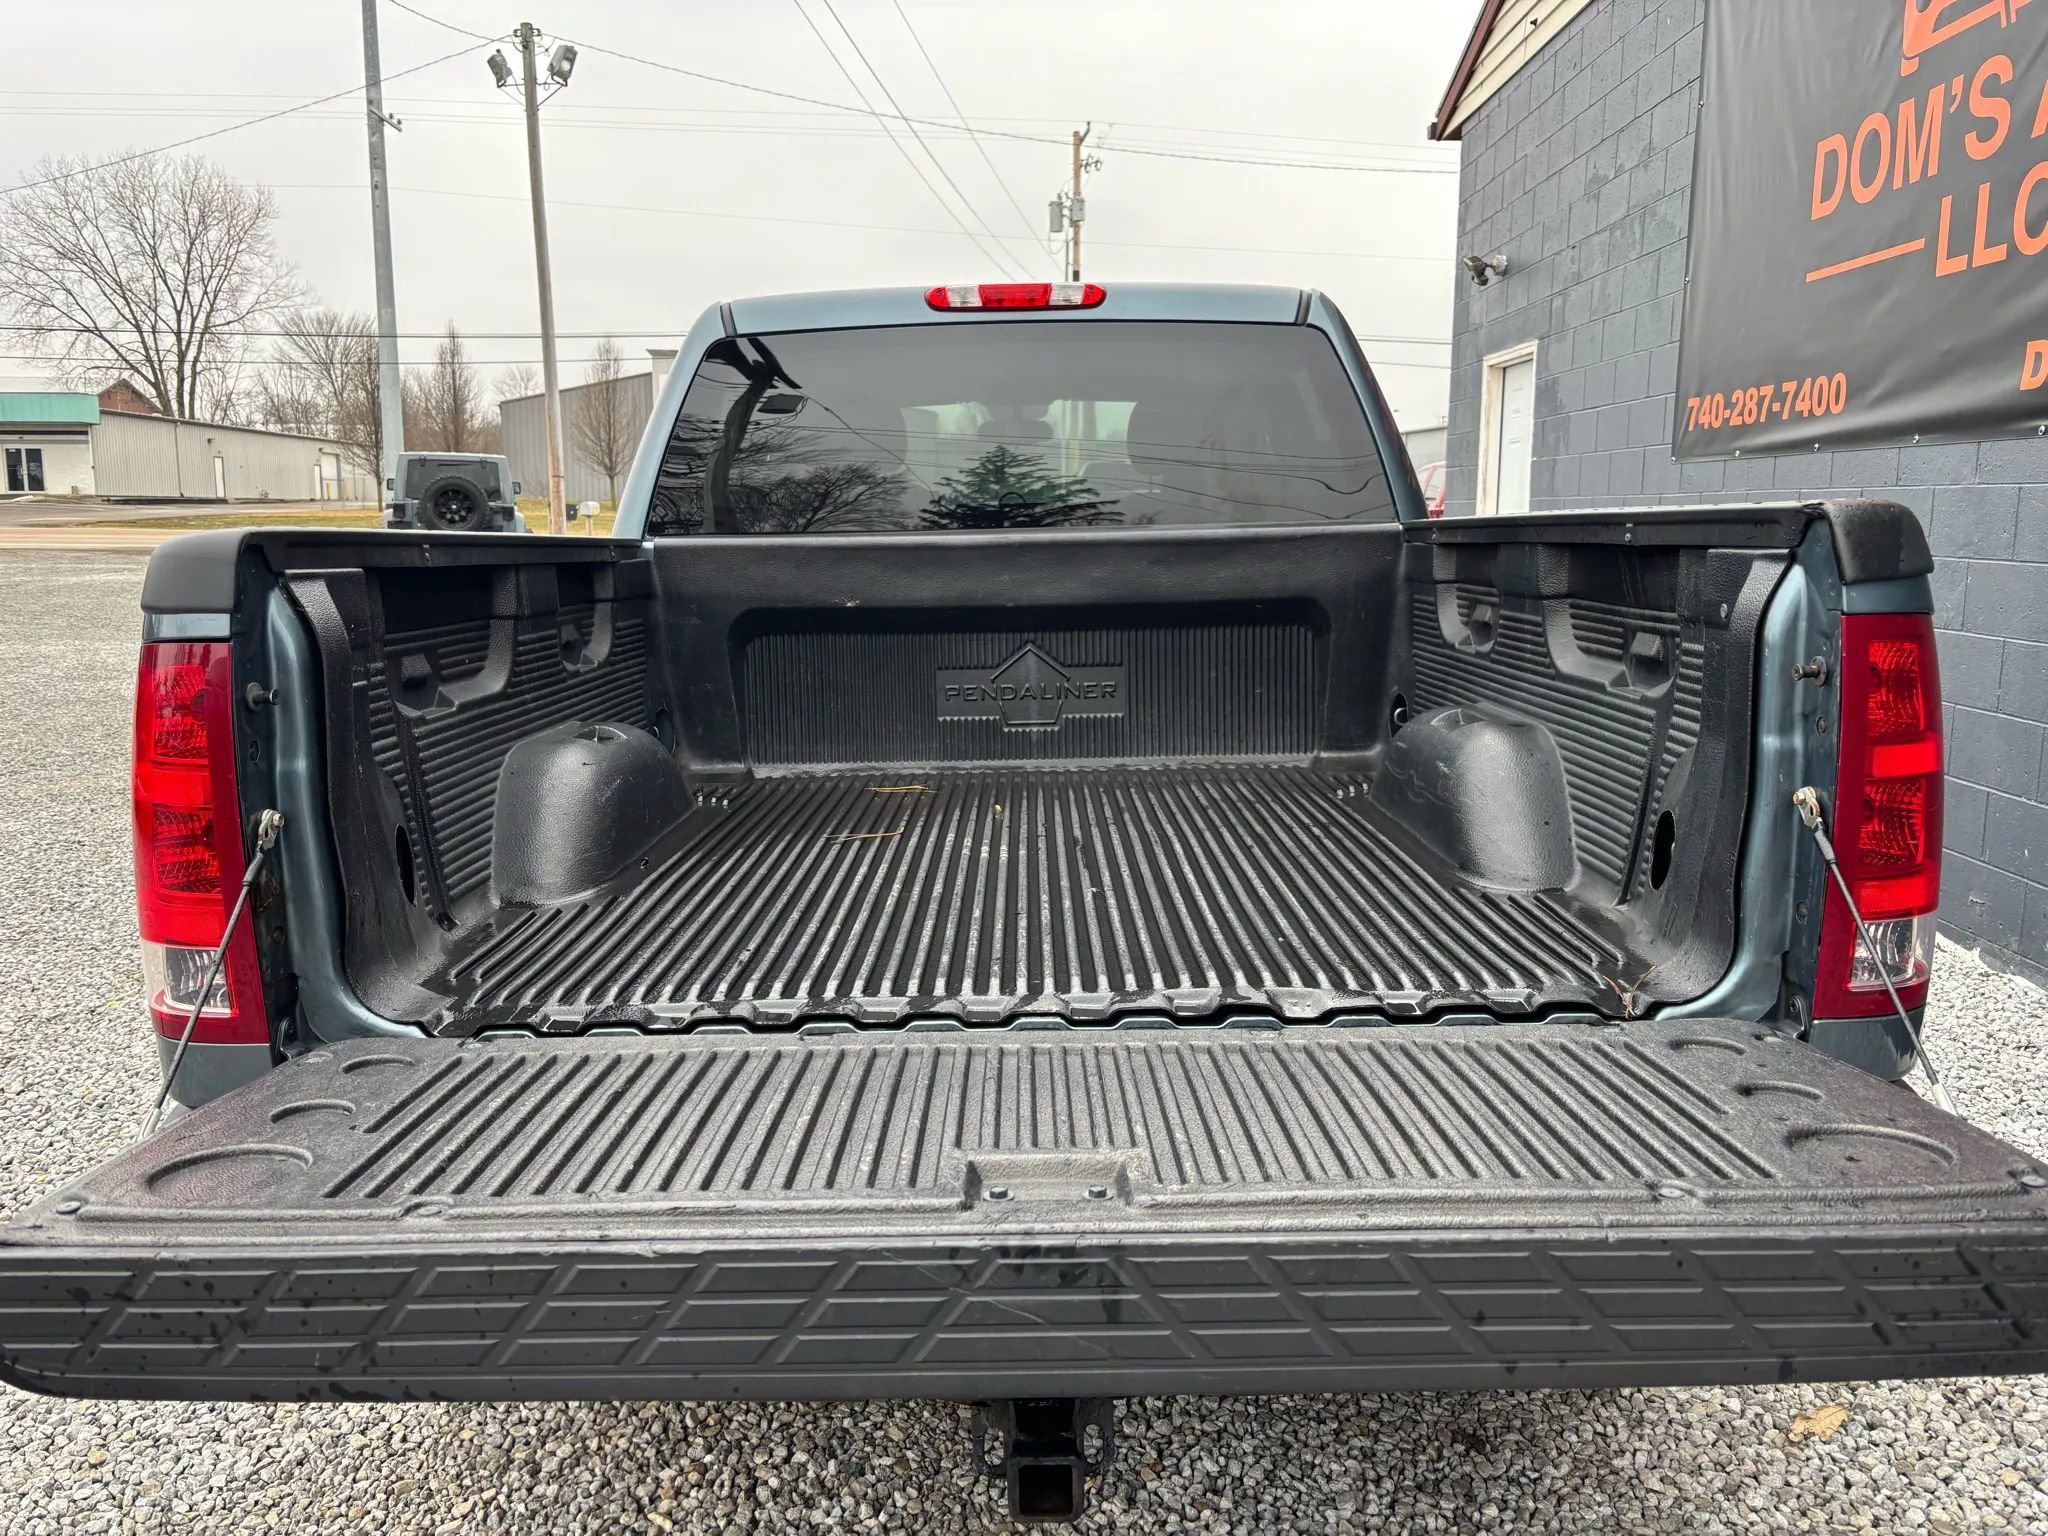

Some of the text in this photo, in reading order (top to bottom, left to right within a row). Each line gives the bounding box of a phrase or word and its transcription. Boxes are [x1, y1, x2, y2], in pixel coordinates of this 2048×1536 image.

[1810, 54, 2014, 220] DOM'S
[1935, 160, 2048, 277] LLC
[1687, 372, 1847, 432] 740-287-7400
[944, 681, 1117, 702] PENDALINER
